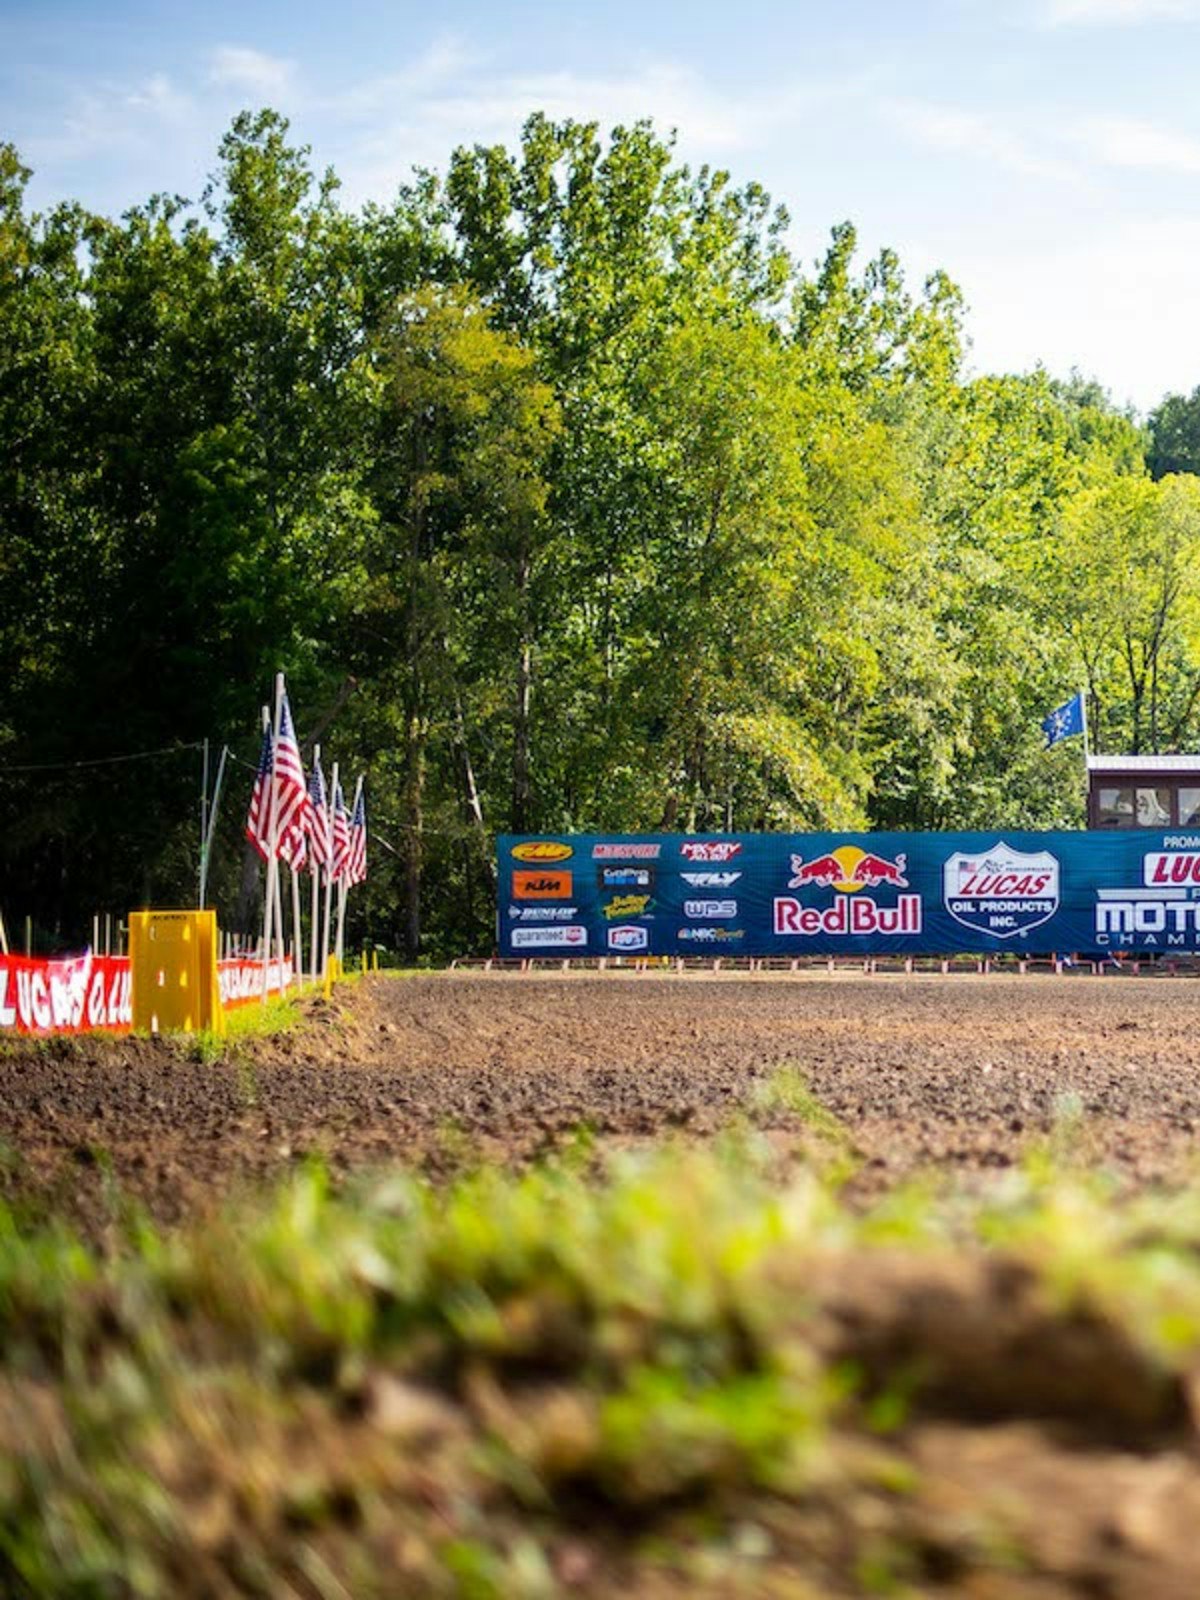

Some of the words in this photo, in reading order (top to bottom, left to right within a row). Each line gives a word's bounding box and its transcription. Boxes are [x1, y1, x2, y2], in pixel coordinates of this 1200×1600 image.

[604, 868, 649, 877] GoPro
[525, 880, 561, 891] KTM
[960, 874, 1051, 895] LUCAS
[520, 907, 578, 917] DUNLOP
[685, 901, 737, 918] WPS
[952, 902, 976, 912] OIL
[980, 901, 1053, 912] PRODUCTS
[776, 896, 847, 933] Red
[851, 896, 921, 933] Bull
[989, 916, 1019, 927] INC.
